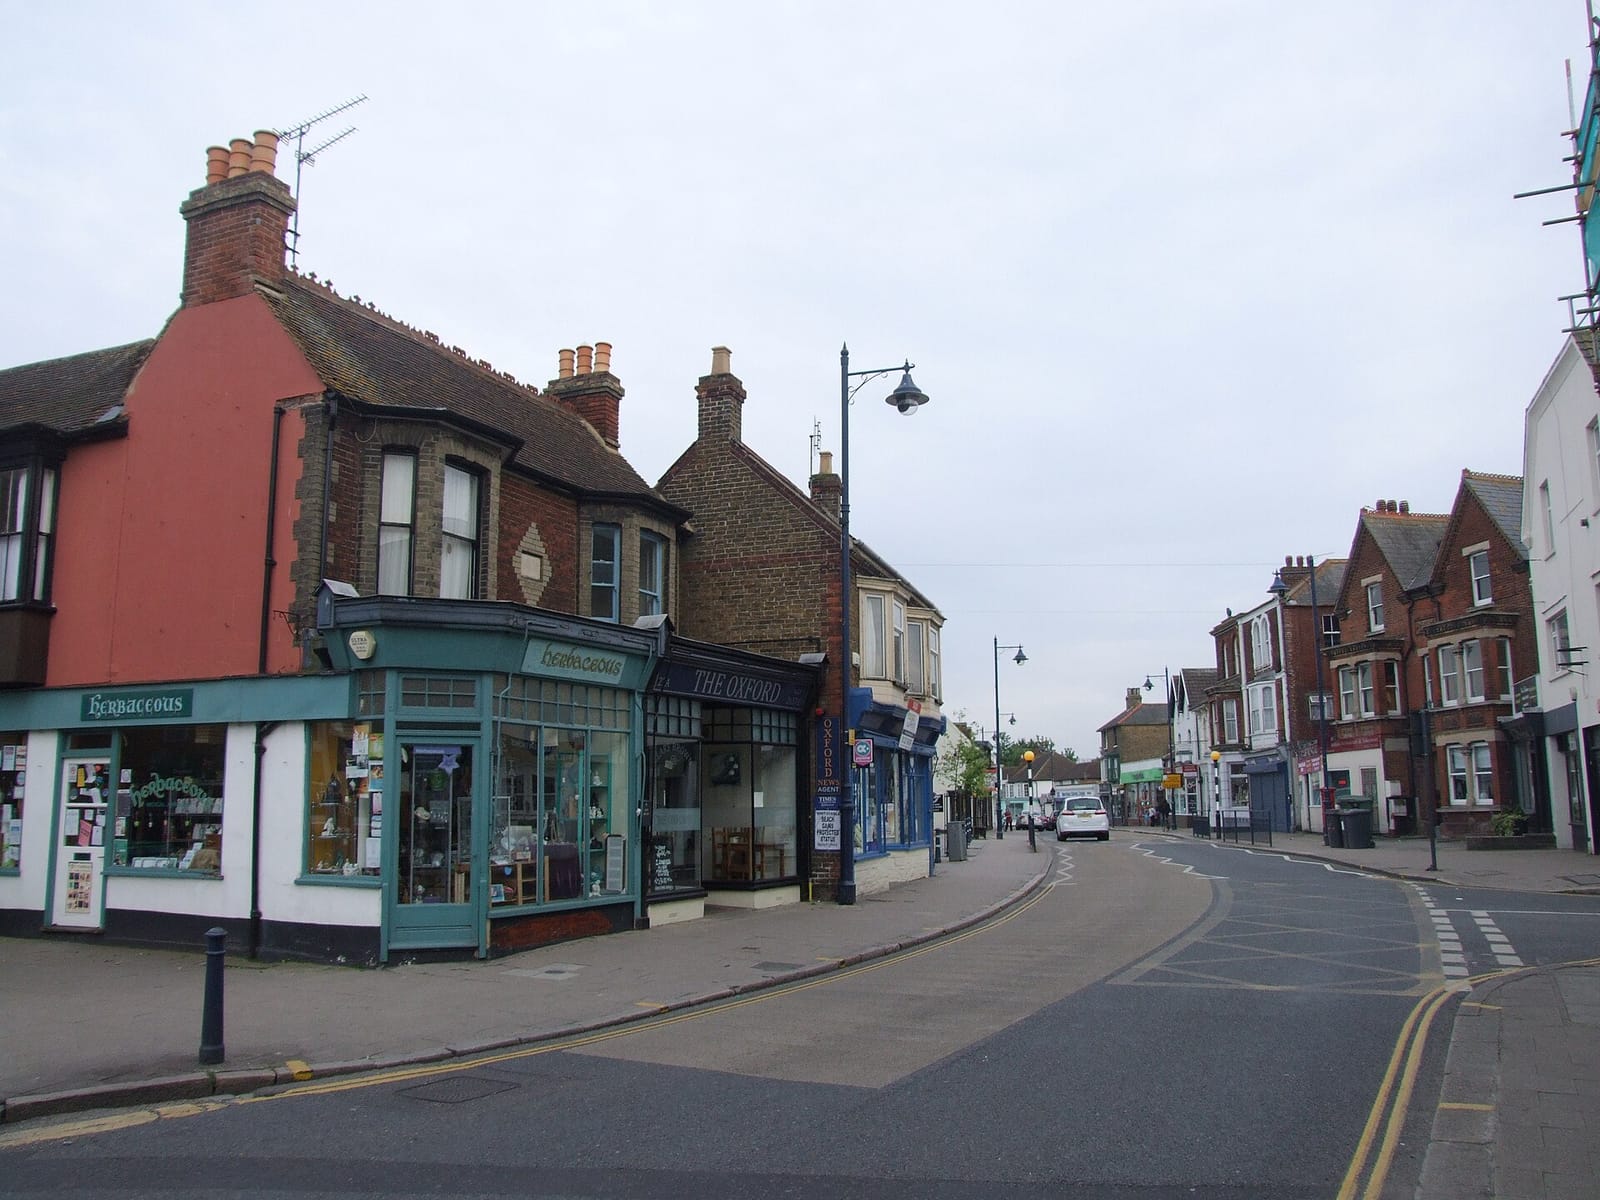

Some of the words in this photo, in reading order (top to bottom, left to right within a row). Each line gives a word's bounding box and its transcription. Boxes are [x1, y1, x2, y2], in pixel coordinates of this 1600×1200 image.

[694, 669, 726, 697] THE
[726, 674, 782, 704] OXFORD
[824, 719, 832, 777] OXFORD
